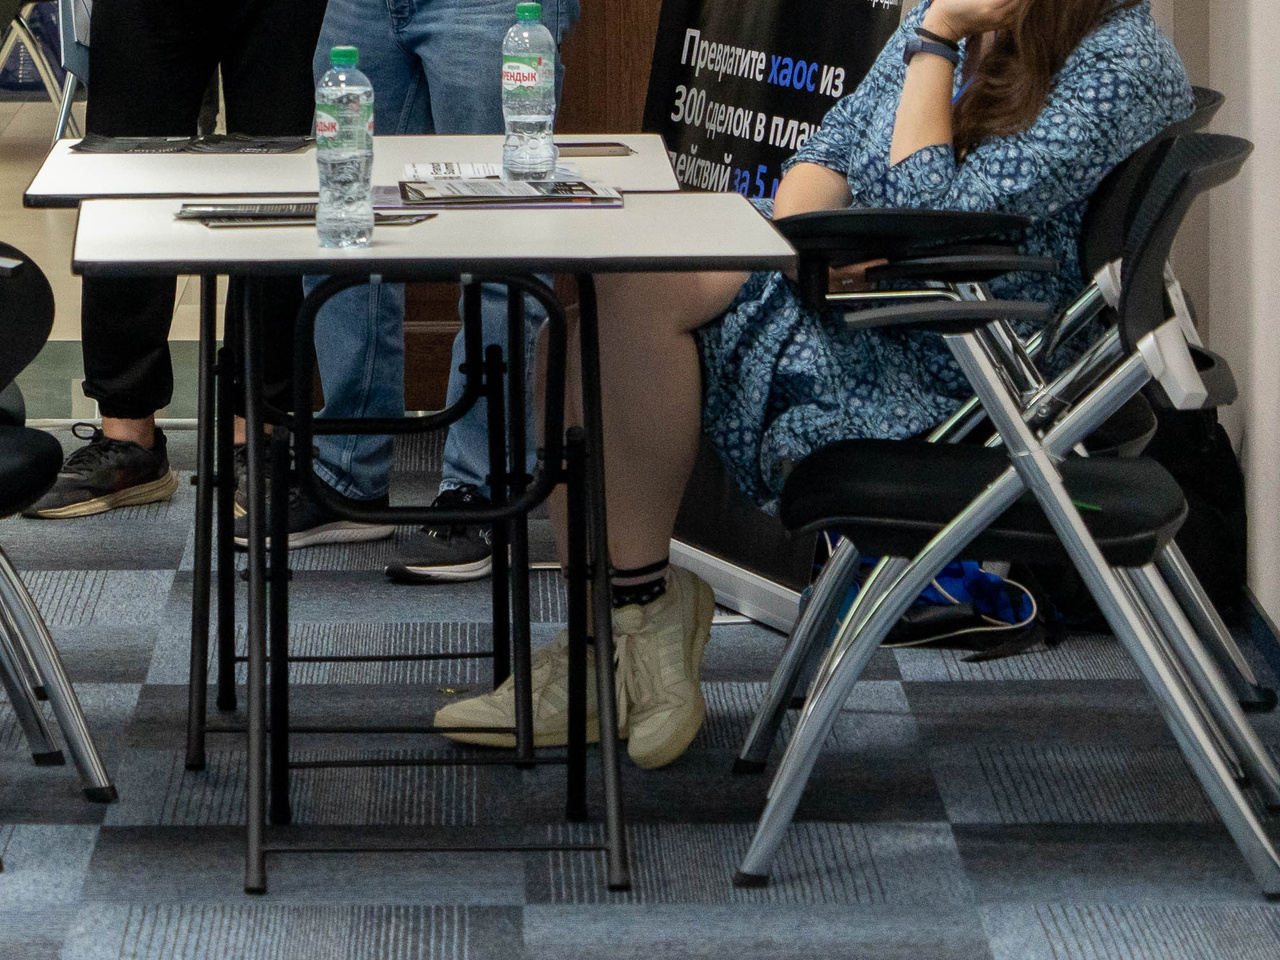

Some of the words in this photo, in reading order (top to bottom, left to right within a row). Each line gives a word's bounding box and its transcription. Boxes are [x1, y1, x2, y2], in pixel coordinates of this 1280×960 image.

[681, 28, 766, 82] Превратите
[767, 54, 818, 93] хаос
[819, 65, 845, 98] из
[670, 85, 706, 127] 300
[705, 100, 753, 140] сделок
[754, 112, 766, 142] в
[733, 168, 751, 195] за
[753, 165, 768, 199] 5
